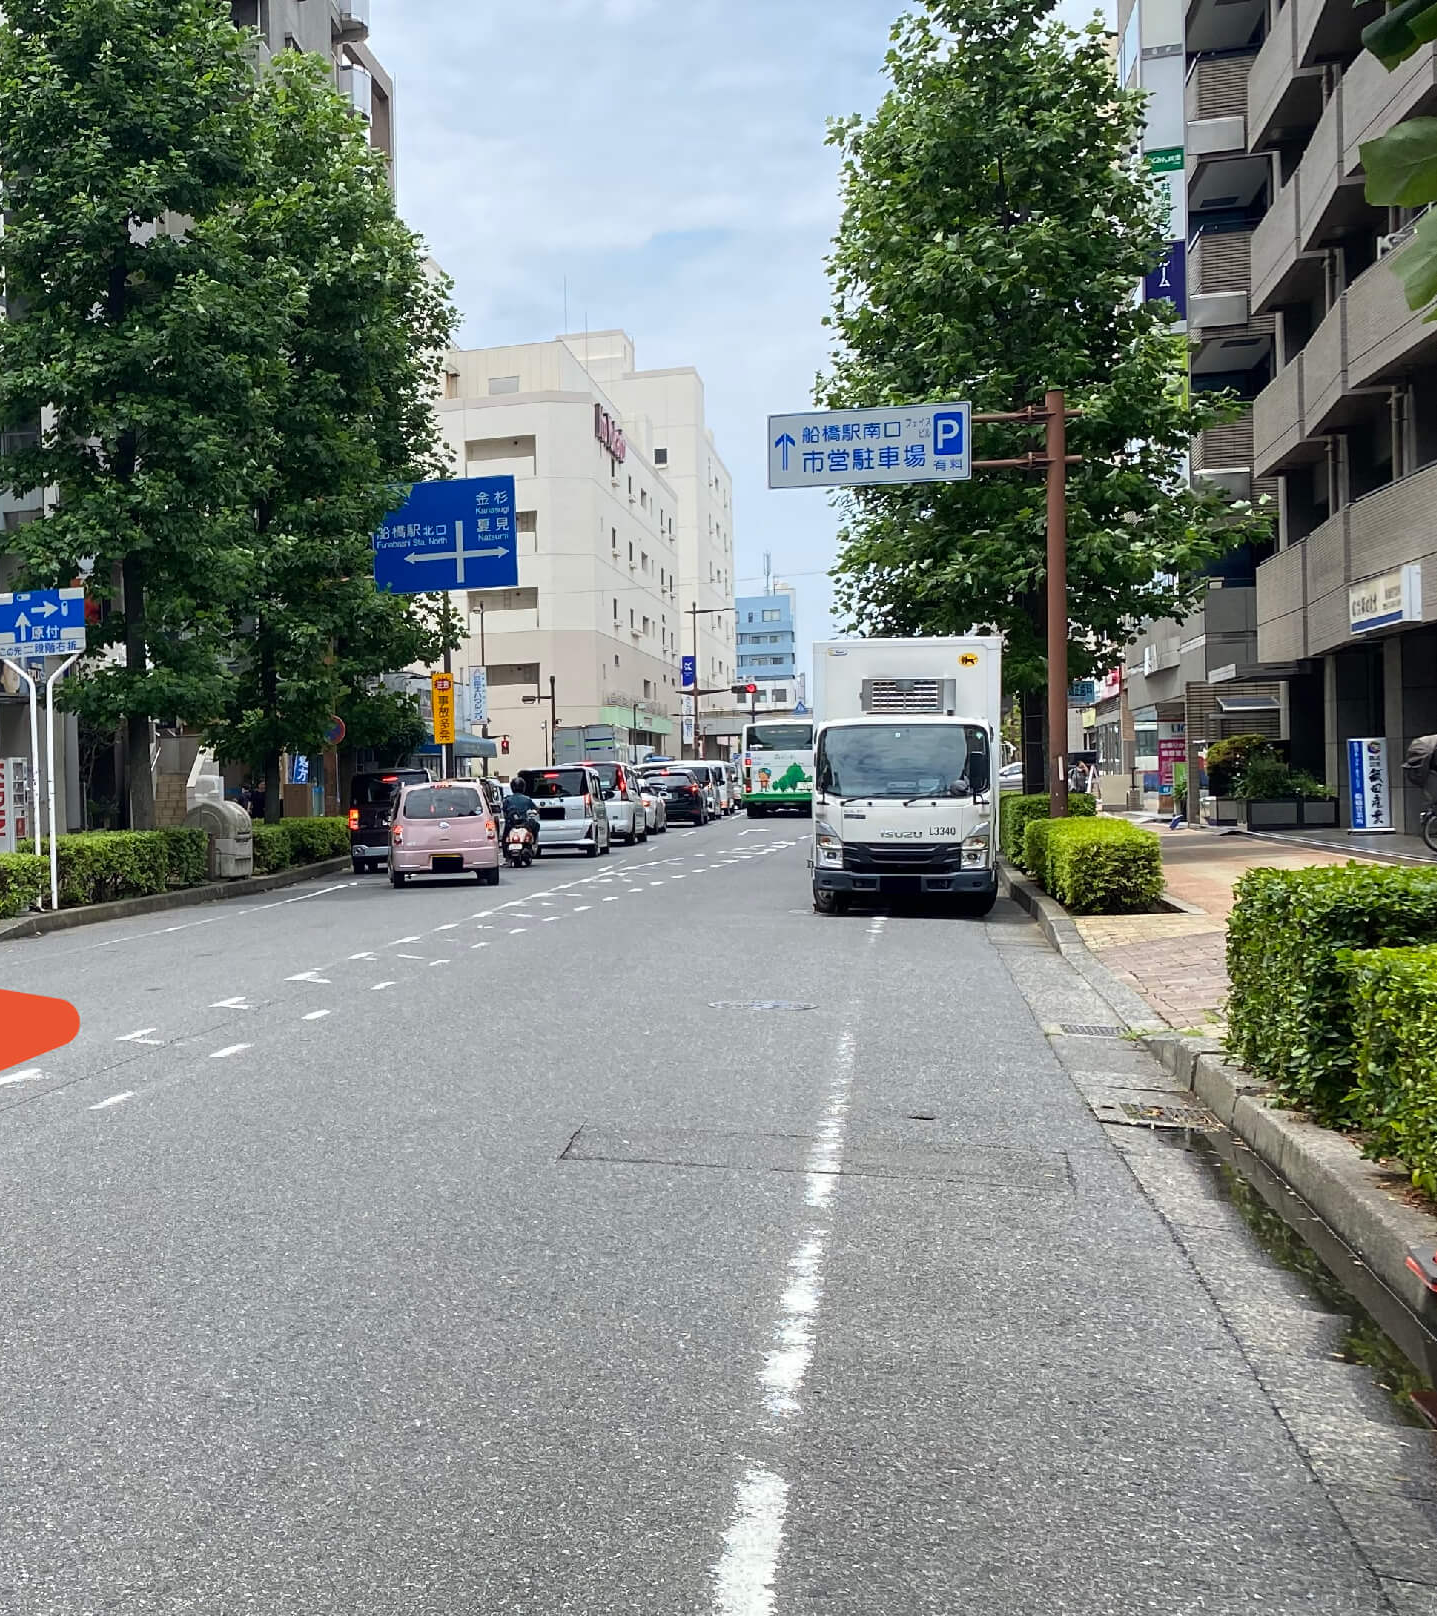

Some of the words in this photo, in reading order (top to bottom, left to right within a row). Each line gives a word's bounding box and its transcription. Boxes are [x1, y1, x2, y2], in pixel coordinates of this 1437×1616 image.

[802, 421, 901, 444] 船橋駅南口
[936, 418, 960, 449] P
[802, 444, 926, 473] 市営駐車場
[933, 458, 963, 472] 有料
[475, 490, 509, 506] 金杉
[376, 523, 447, 541] 船橋駅北口
[476, 517, 510, 533] 夏見
[428, 537, 448, 545] North
[478, 533, 509, 542] Natsumi
[31, 625, 60, 641] 原付
[880, 830, 923, 839] ISUZU
[929, 827, 957, 836] L3340
